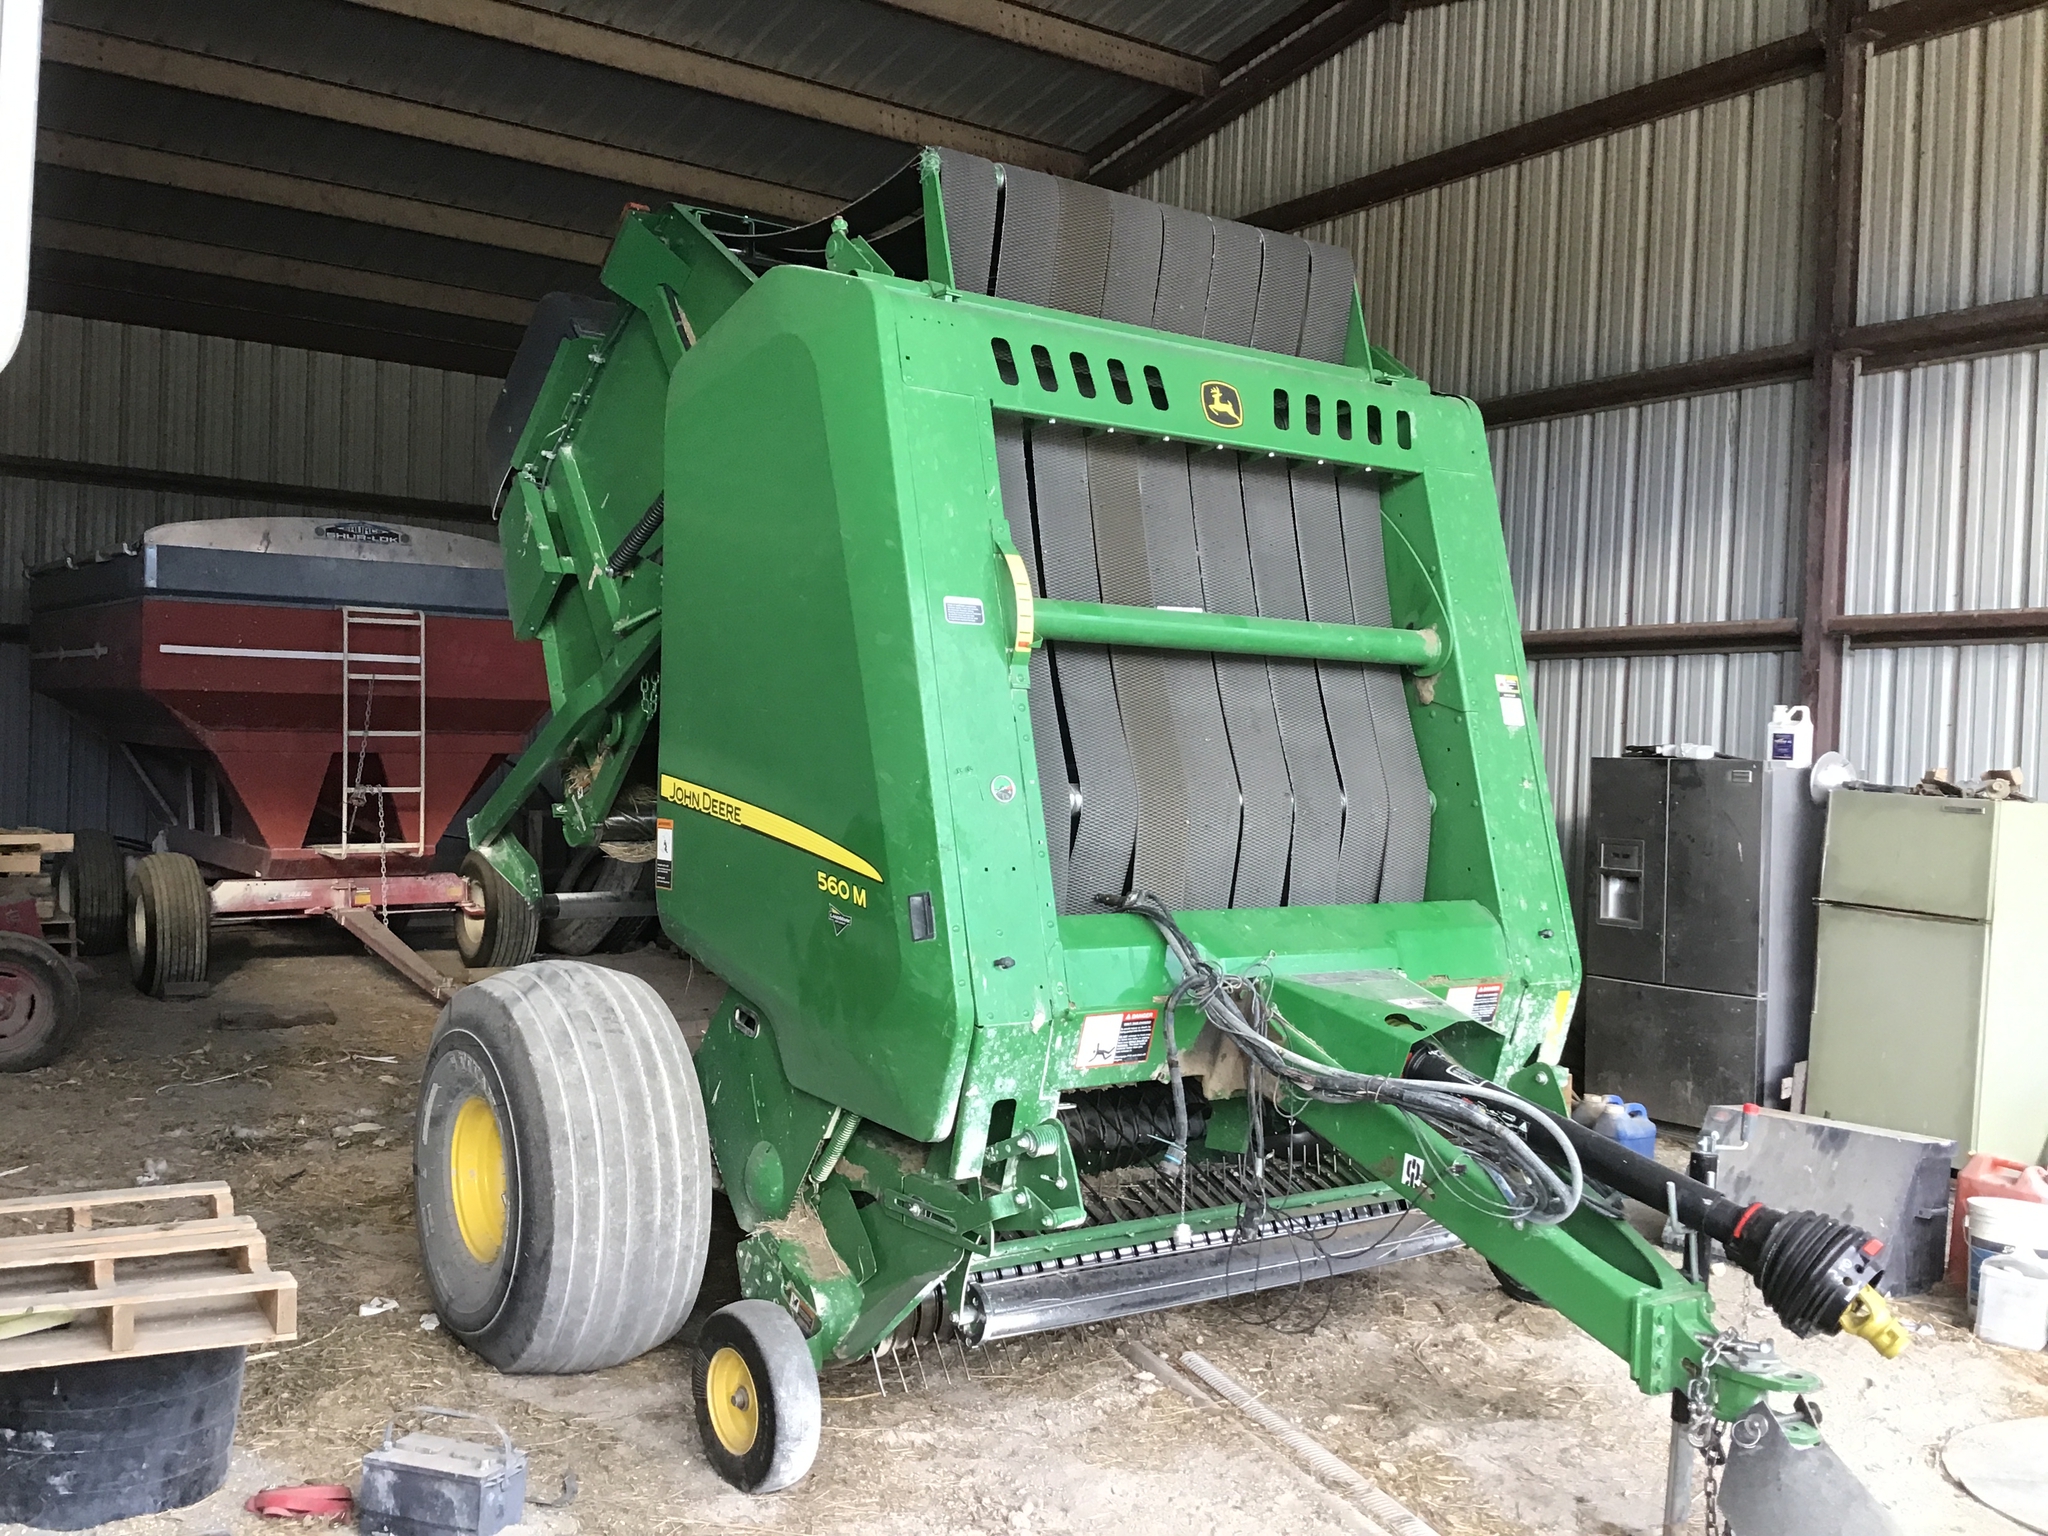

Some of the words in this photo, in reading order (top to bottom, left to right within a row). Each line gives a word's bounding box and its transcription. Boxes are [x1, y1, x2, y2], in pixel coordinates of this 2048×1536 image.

[326, 531, 399, 543] SHUR-LOK
[669, 782, 700, 808] JOHN
[702, 792, 742, 823] DEERE
[817, 870, 850, 900] 560
[852, 884, 867, 909] M
